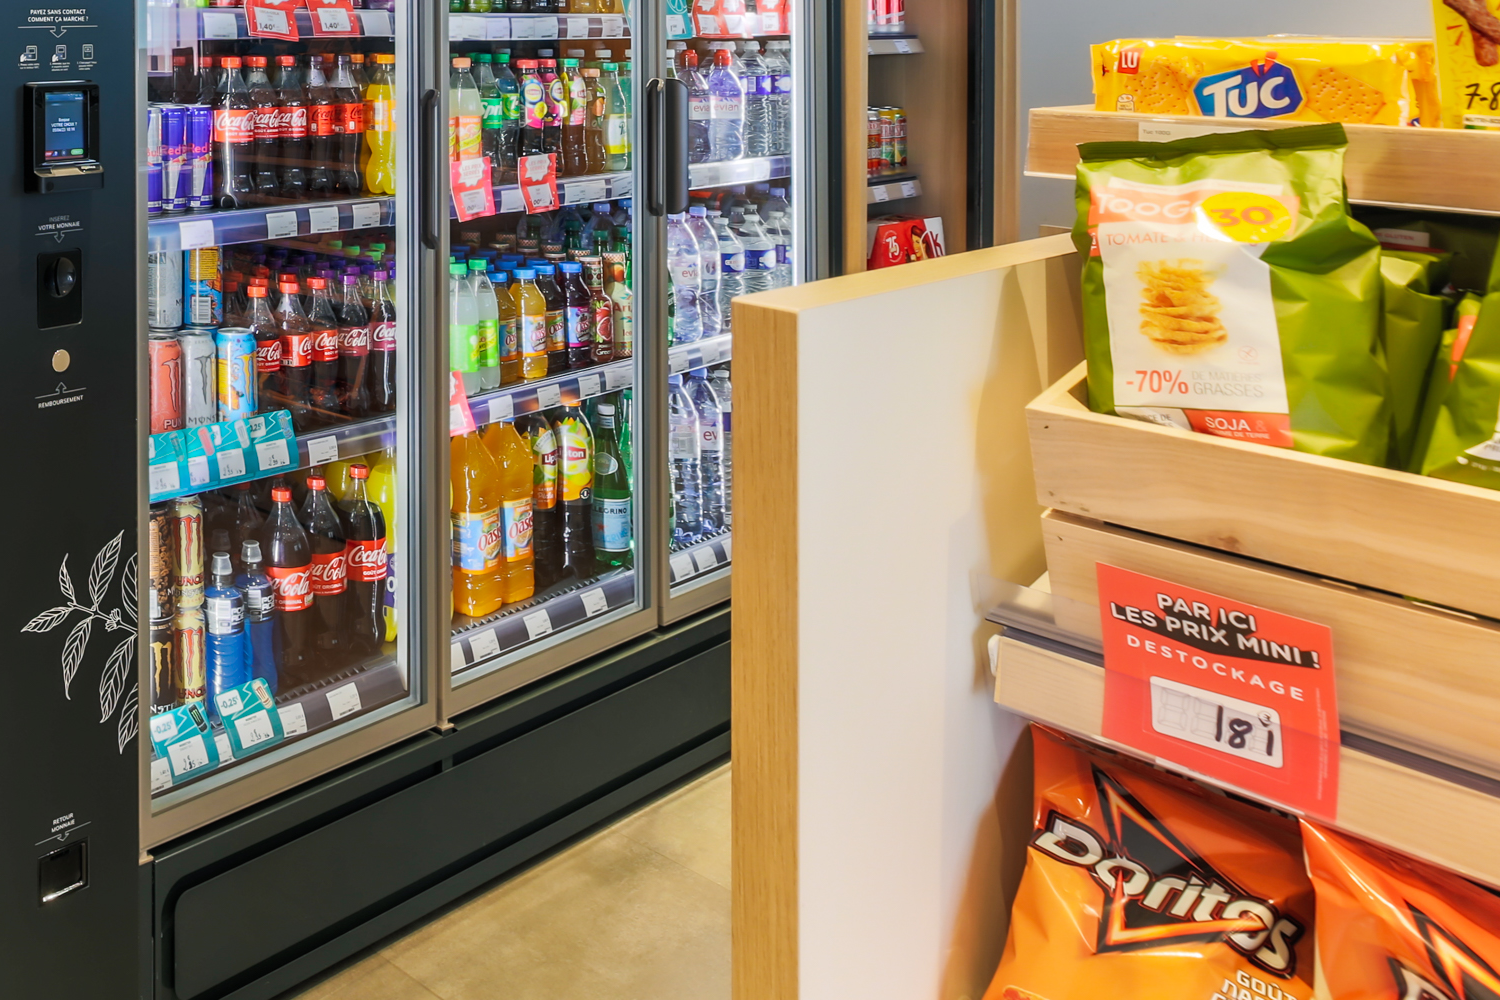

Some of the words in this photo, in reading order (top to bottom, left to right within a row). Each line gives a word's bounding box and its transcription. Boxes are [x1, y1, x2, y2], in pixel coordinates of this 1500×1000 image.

[1121, 52, 1139, 69] LU
[714, 103, 739, 112] evian
[1096, 192, 1202, 218] TOOG
[57, 221, 80, 229] MONNAIE
[1106, 232, 1169, 245] TOMATE
[1126, 370, 1189, 394] -70%
[1192, 371, 1207, 381] DE
[1209, 370, 1262, 382] MATIÈRES
[1193, 382, 1264, 398] GRASSES
[38, 395, 84, 409] REMBOURSEMENT
[1205, 417, 1251, 431] SOJA
[1247, 432, 1270, 440] TERRE
[1157, 594, 1211, 621] PAR
[1219, 608, 1256, 631] ICI
[1110, 602, 1157, 628] LES
[1166, 616, 1229, 646] PRIX
[1236, 634, 1302, 665] MINI
[1312, 651, 1321, 669] !
[1126, 634, 1304, 702] DESTOCKAGE
[51, 819, 76, 833] MONNAIE
[53, 813, 74, 826] RETOUR
[1035, 817, 1300, 973] Doritos
